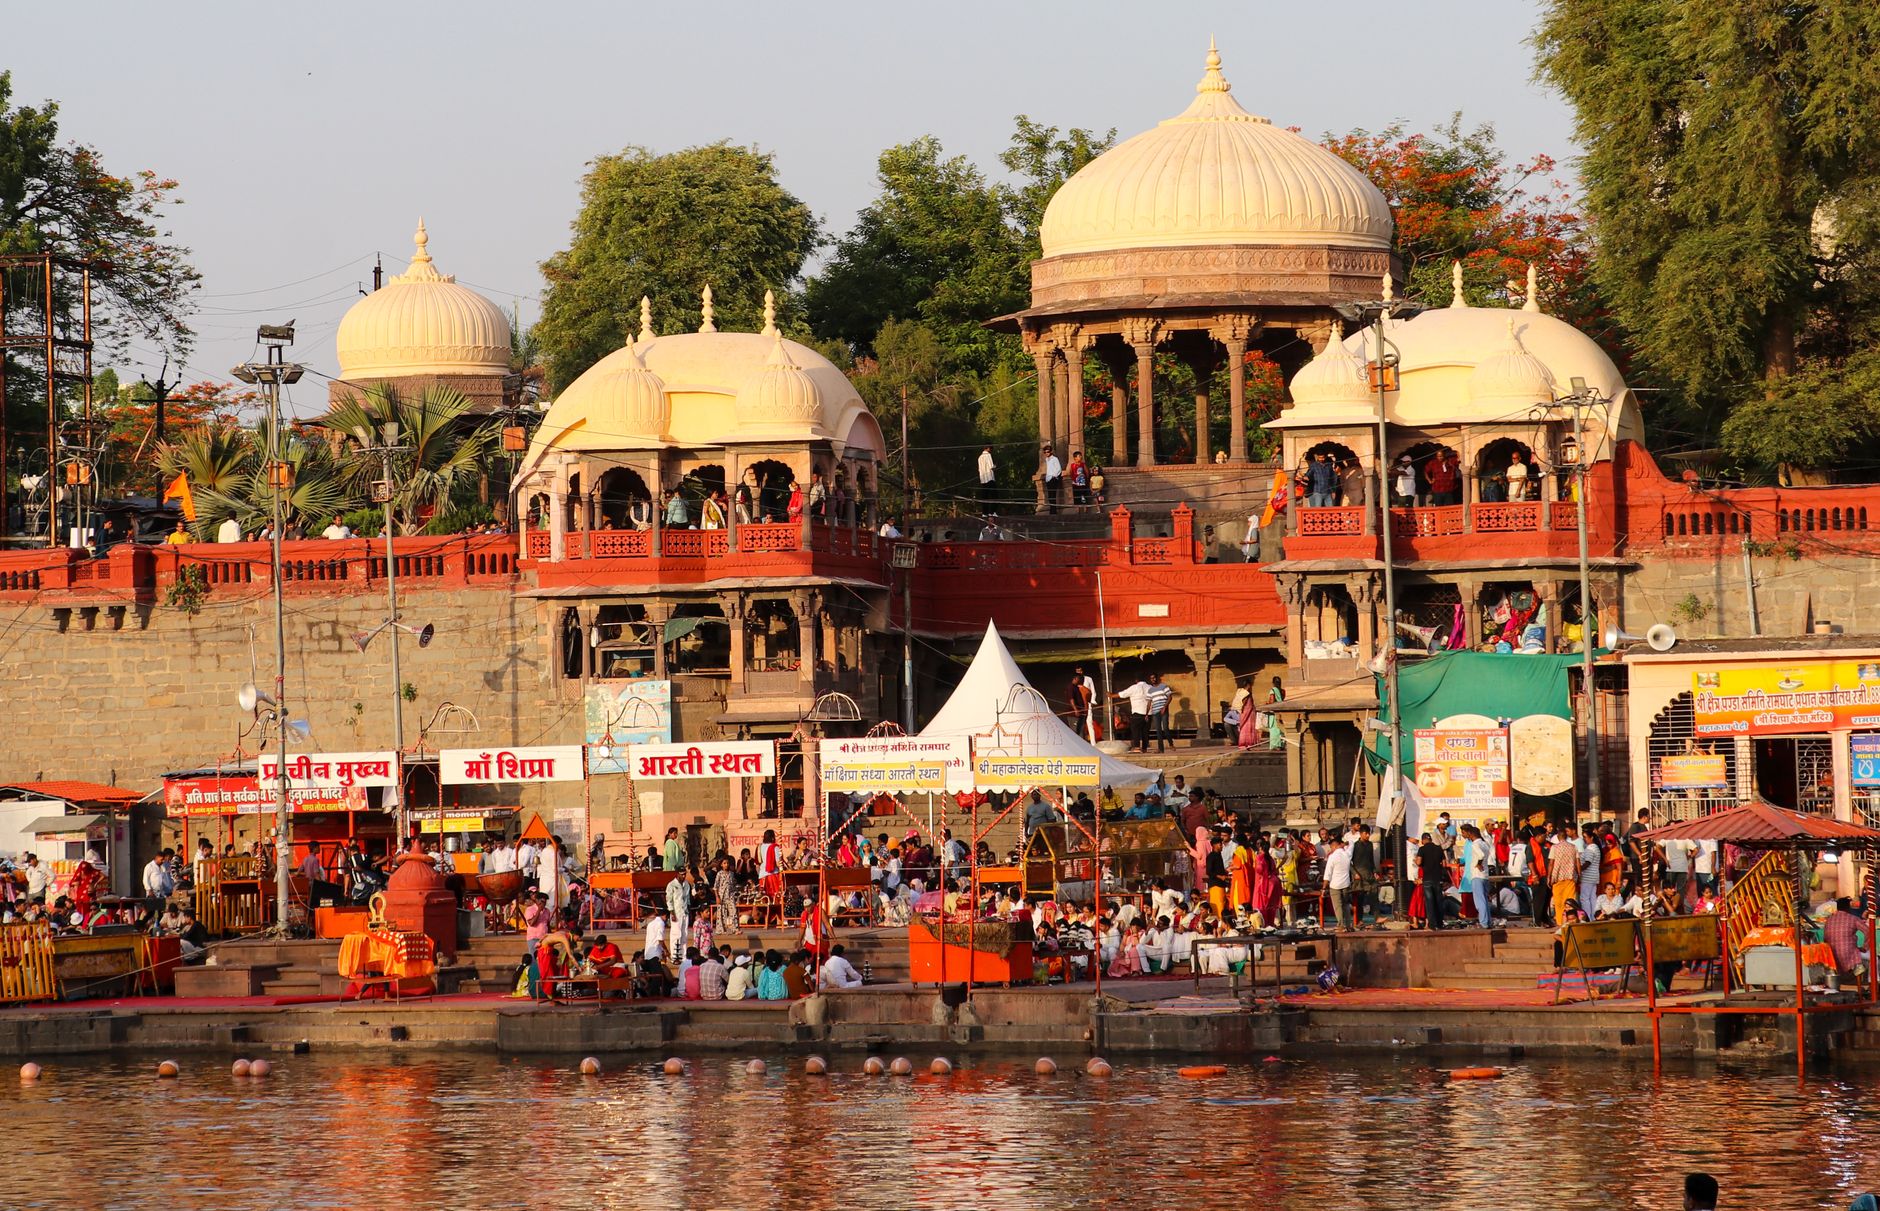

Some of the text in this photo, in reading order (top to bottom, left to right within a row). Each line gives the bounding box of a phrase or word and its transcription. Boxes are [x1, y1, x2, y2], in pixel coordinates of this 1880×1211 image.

[1722, 697, 1740, 710] पण्डा
[1741, 690, 1765, 709] समिति
[1767, 694, 1794, 708] रामघाट
[1818, 685, 1851, 705] कार्यालय
[920, 743, 950, 751] रामघाट
[1447, 738, 1476, 747] पण्डा
[638, 747, 762, 776] आरती स्थल
[1437, 748, 1486, 761] लोटा वाला
[262, 756, 389, 786] प्रचीन मुख्य
[464, 752, 555, 779] माँ शिप्रा
[861, 767, 885, 780] संध्या
[888, 765, 916, 780] आरती
[918, 768, 940, 780] स्थल
[979, 760, 989, 775] श्री
[992, 760, 1044, 776] महाकालेश्वर
[1065, 764, 1097, 774] रामघाट
[186, 788, 202, 804] अति
[233, 786, 266, 802] सर्वकाय
[1511, 852, 1518, 866] 7
